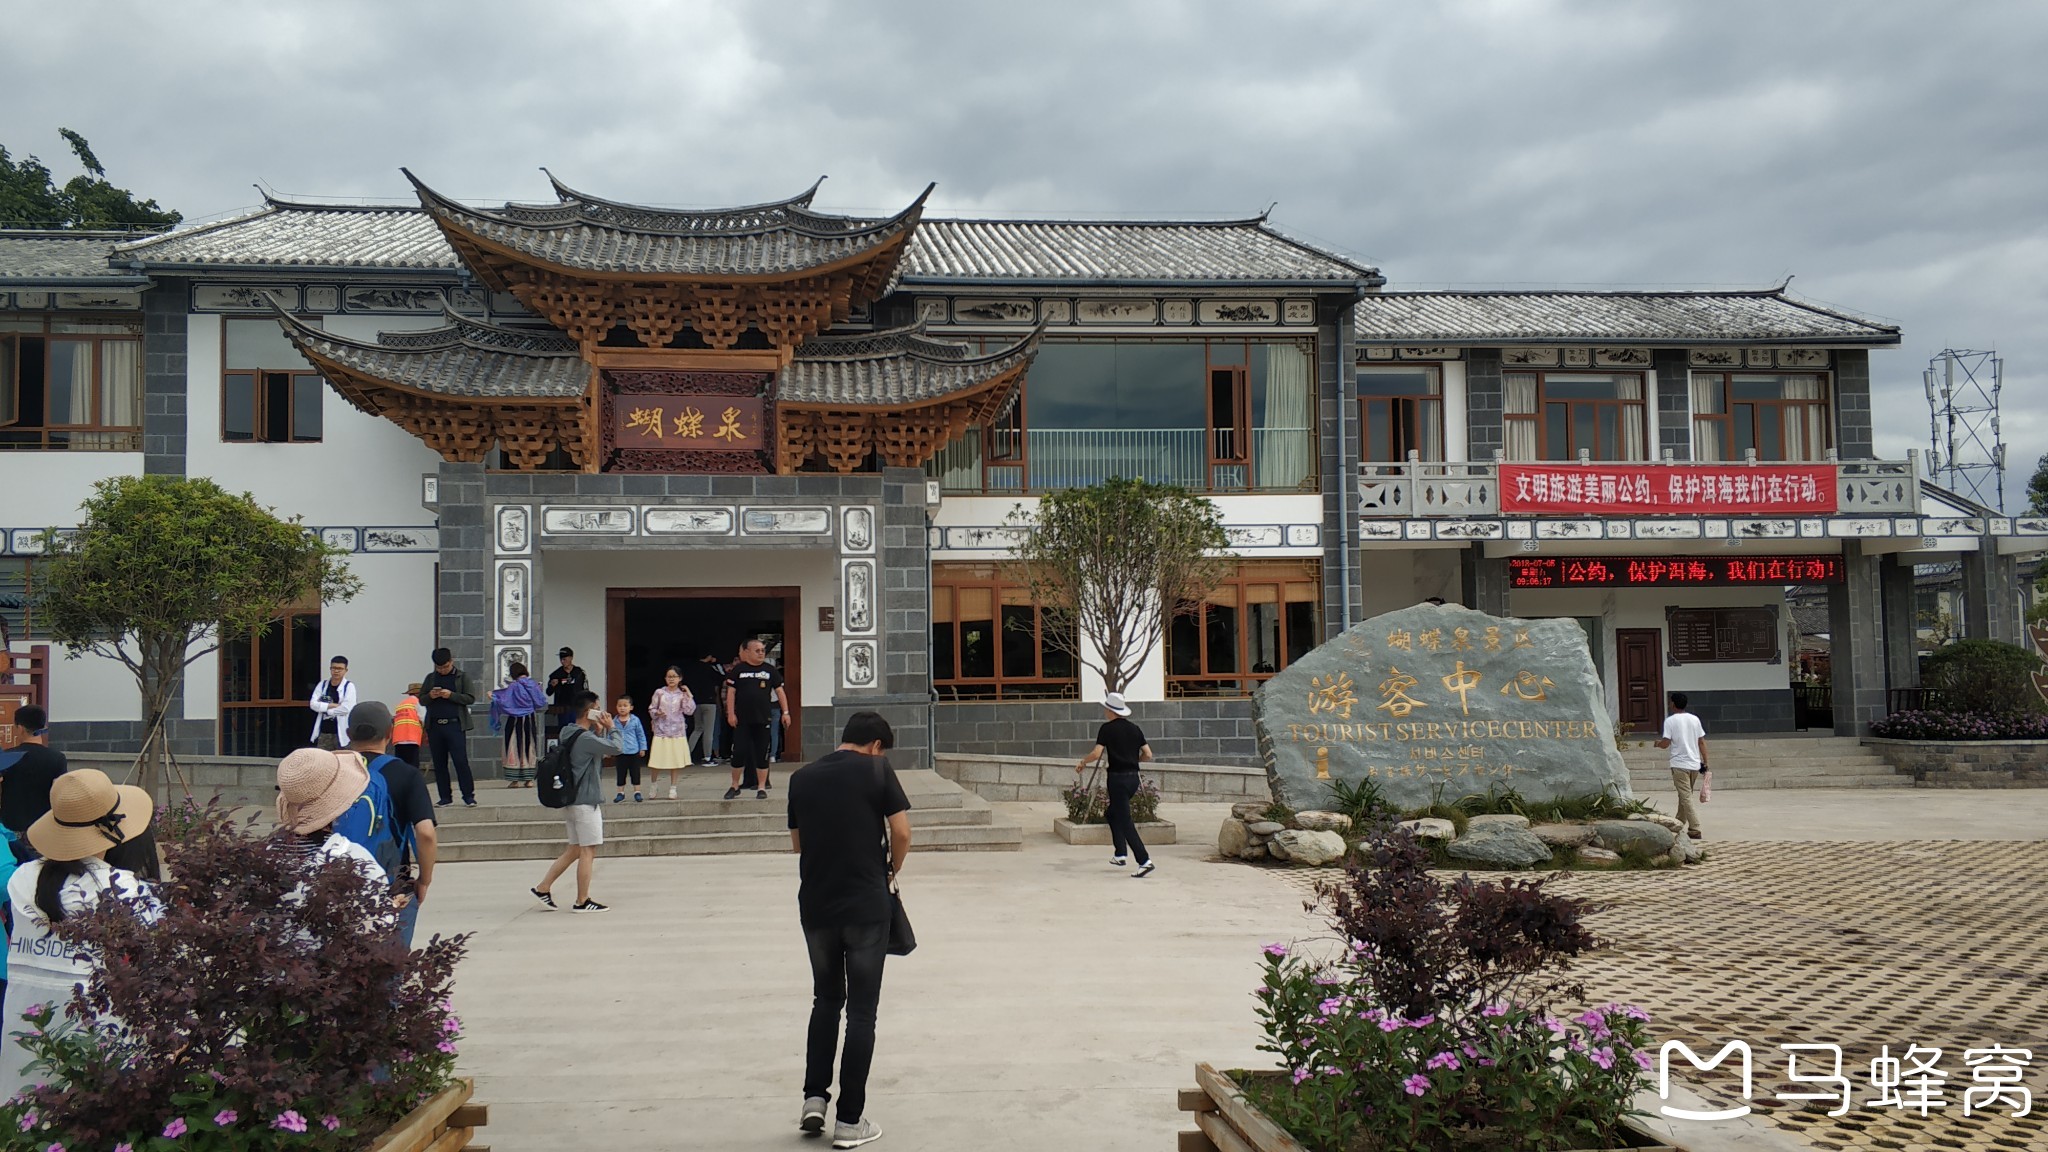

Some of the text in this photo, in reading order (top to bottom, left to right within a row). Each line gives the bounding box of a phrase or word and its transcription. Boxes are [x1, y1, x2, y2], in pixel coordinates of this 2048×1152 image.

[626, 406, 747, 443] 蝴蝶泉
[1308, 660, 1556, 718] 游客中心
